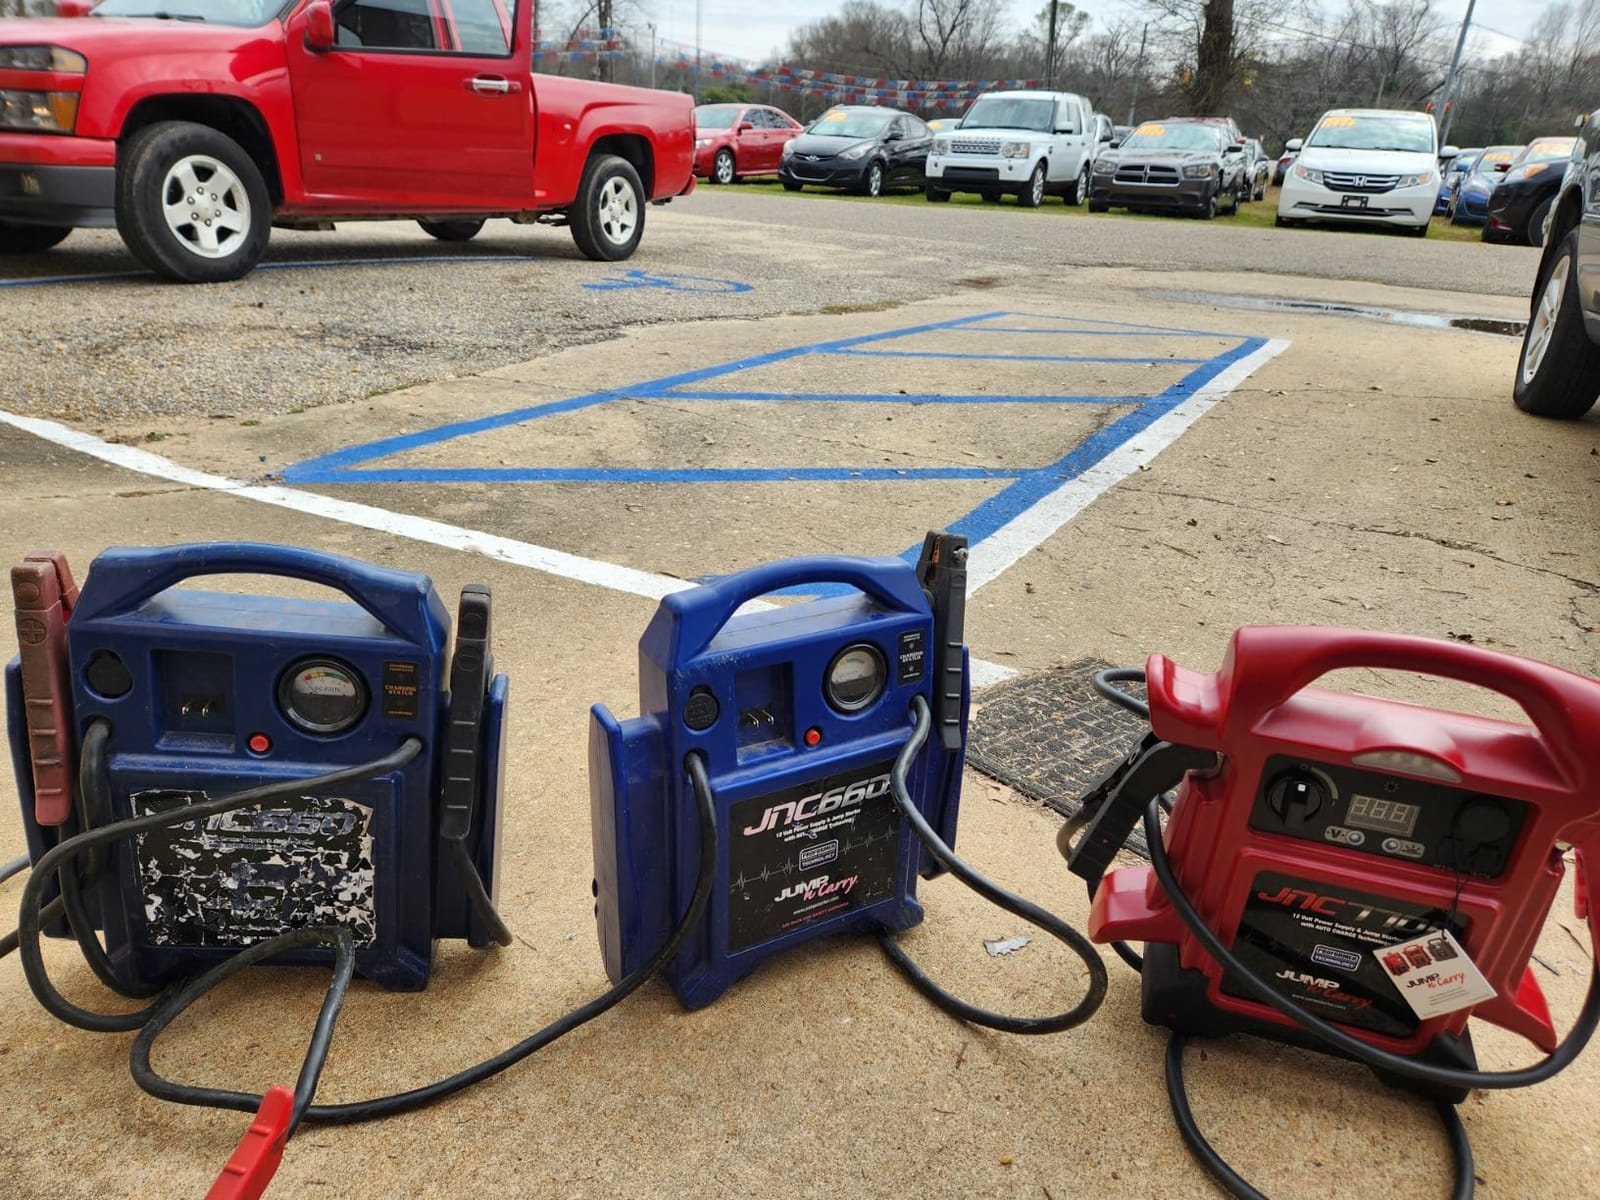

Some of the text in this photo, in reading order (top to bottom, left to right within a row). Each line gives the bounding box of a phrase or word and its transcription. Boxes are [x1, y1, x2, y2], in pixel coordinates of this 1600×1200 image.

[743, 773, 891, 836] JNC660
[774, 875, 829, 902] JUMP
[817, 875, 858, 896] Carry
[1275, 969, 1340, 989] JUMP
[1406, 973, 1440, 988] JUMP
[1437, 972, 1465, 986] Carry
